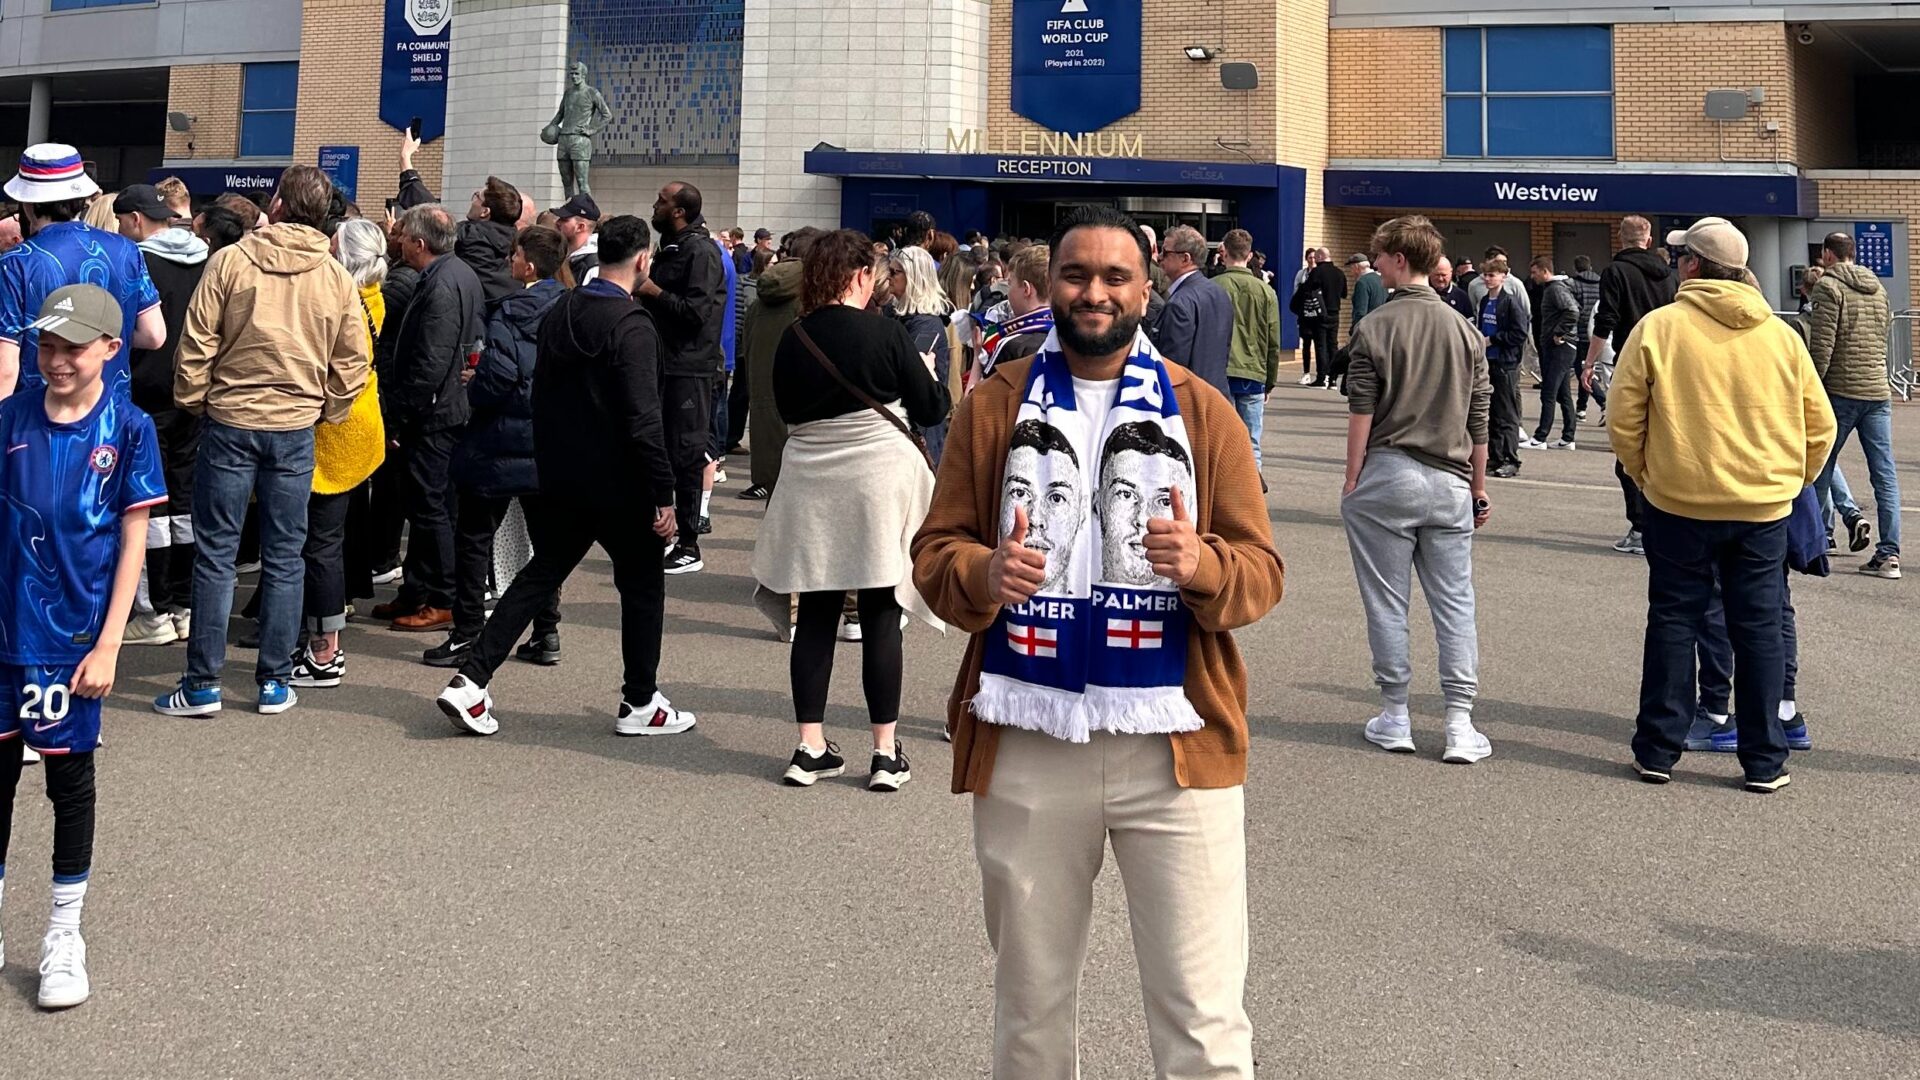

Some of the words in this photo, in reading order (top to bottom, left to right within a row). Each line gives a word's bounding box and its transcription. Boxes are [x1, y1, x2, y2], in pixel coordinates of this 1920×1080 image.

[1046, 20, 1072, 30] FIFA
[1074, 19, 1104, 29] CLUB
[1041, 34, 1082, 44] WORLD
[1085, 33, 1109, 43] CUP
[397, 42, 407, 51] FA
[409, 41, 450, 51] COMMUNI
[412, 53, 442, 62] SHIELD
[1065, 49, 1084, 57] 2021
[1044, 59, 1073, 68] (Played
[1074, 59, 1082, 67] in
[1083, 58, 1105, 67] 2022)
[946, 128, 1143, 158] MILLENNIUM
[997, 159, 1092, 176] RECEPTION
[225, 174, 275, 188] Westview
[1339, 184, 1392, 197] CHELSEA
[1494, 182, 1599, 202] Westview
[1091, 591, 1178, 611] PALMER
[1003, 601, 1076, 620] ALMER
[20, 683, 70, 721] 20
